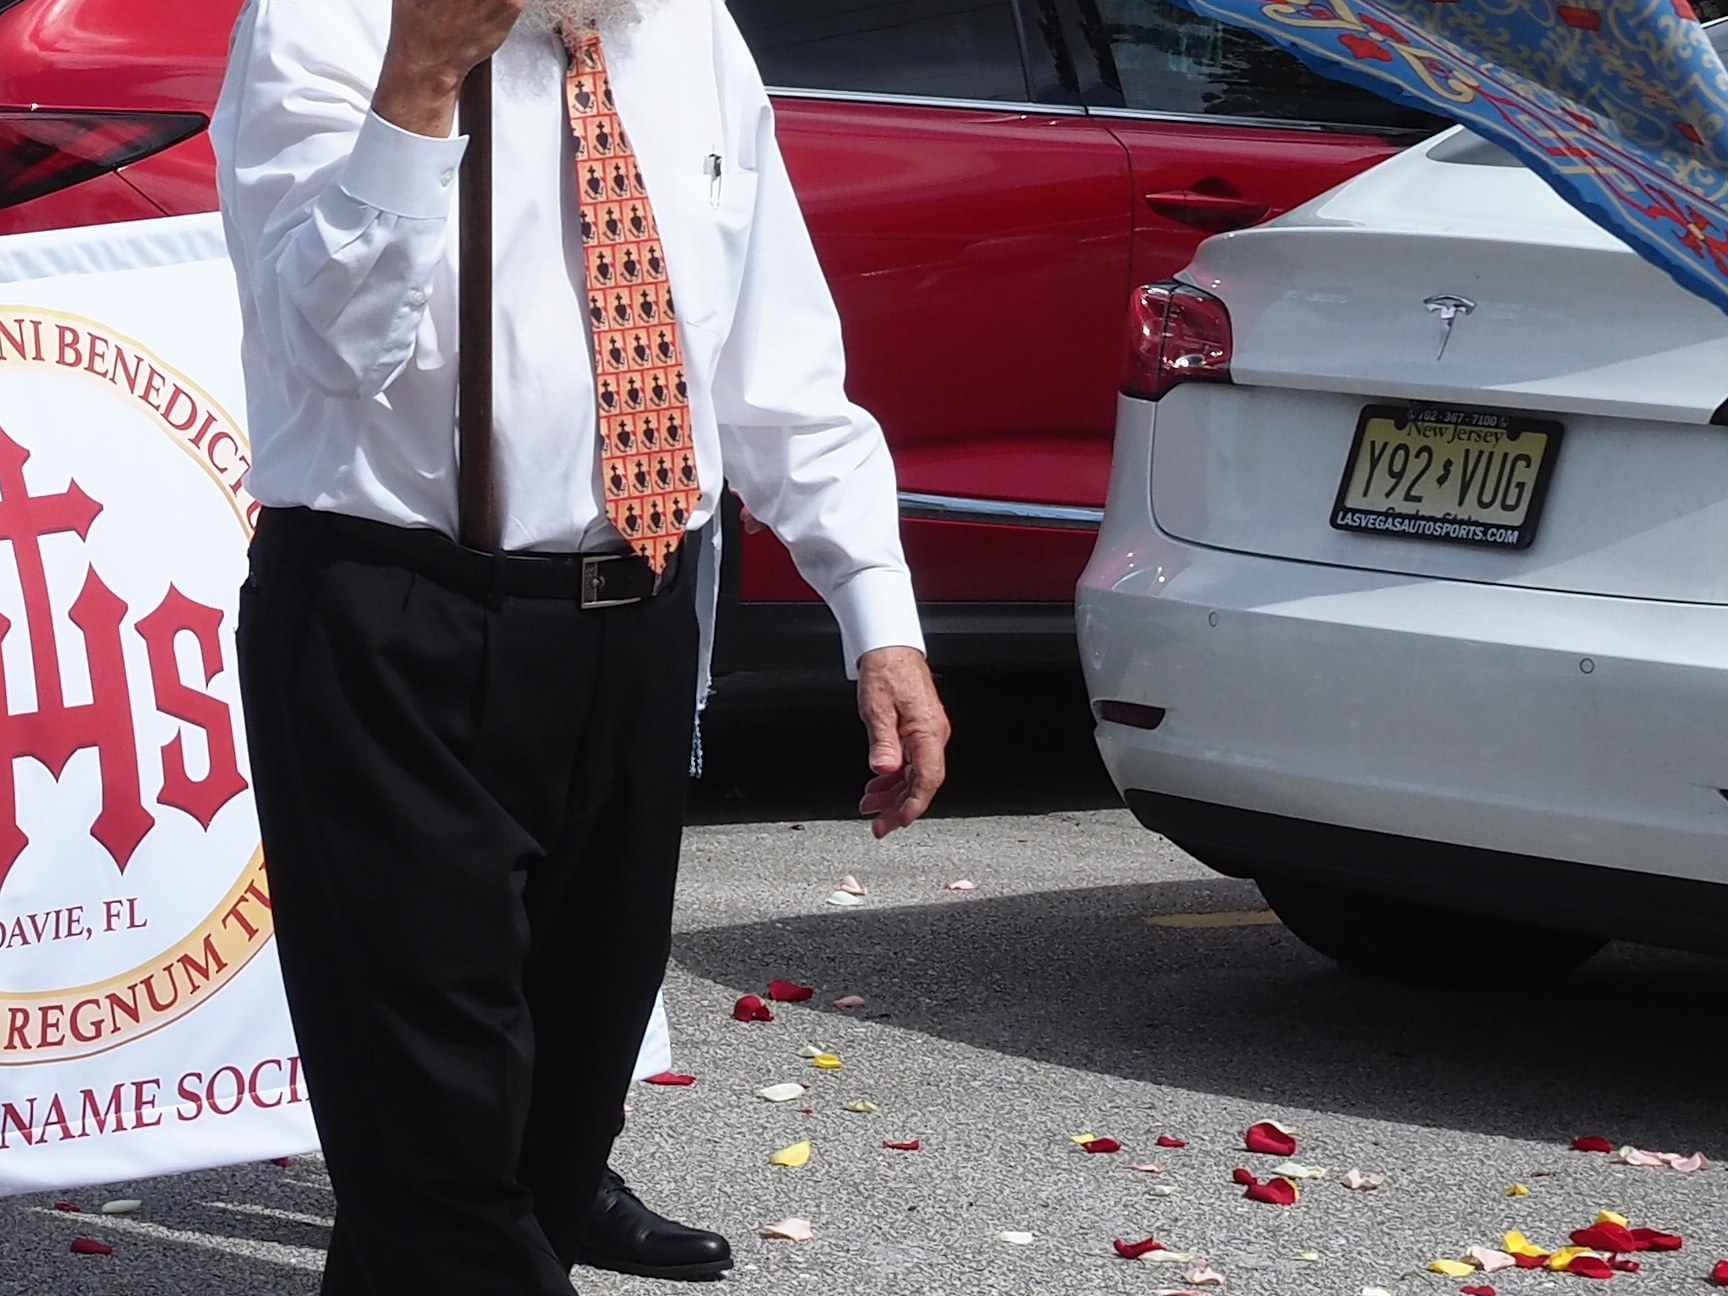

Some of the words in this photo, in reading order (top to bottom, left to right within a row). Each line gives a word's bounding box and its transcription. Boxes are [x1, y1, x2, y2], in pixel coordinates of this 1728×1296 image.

[1406, 422, 1447, 439] New
[1447, 424, 1505, 447] Jersey
[1362, 439, 1434, 504] Y92
[1458, 448, 1532, 513] VUG
[1337, 510, 1520, 545] LASVEGASAUTOSPORTS.COM
[102, 897, 148, 933] FL
[4, 933, 229, 1050] REGNUM
[176, 1055, 310, 1122] SOCI
